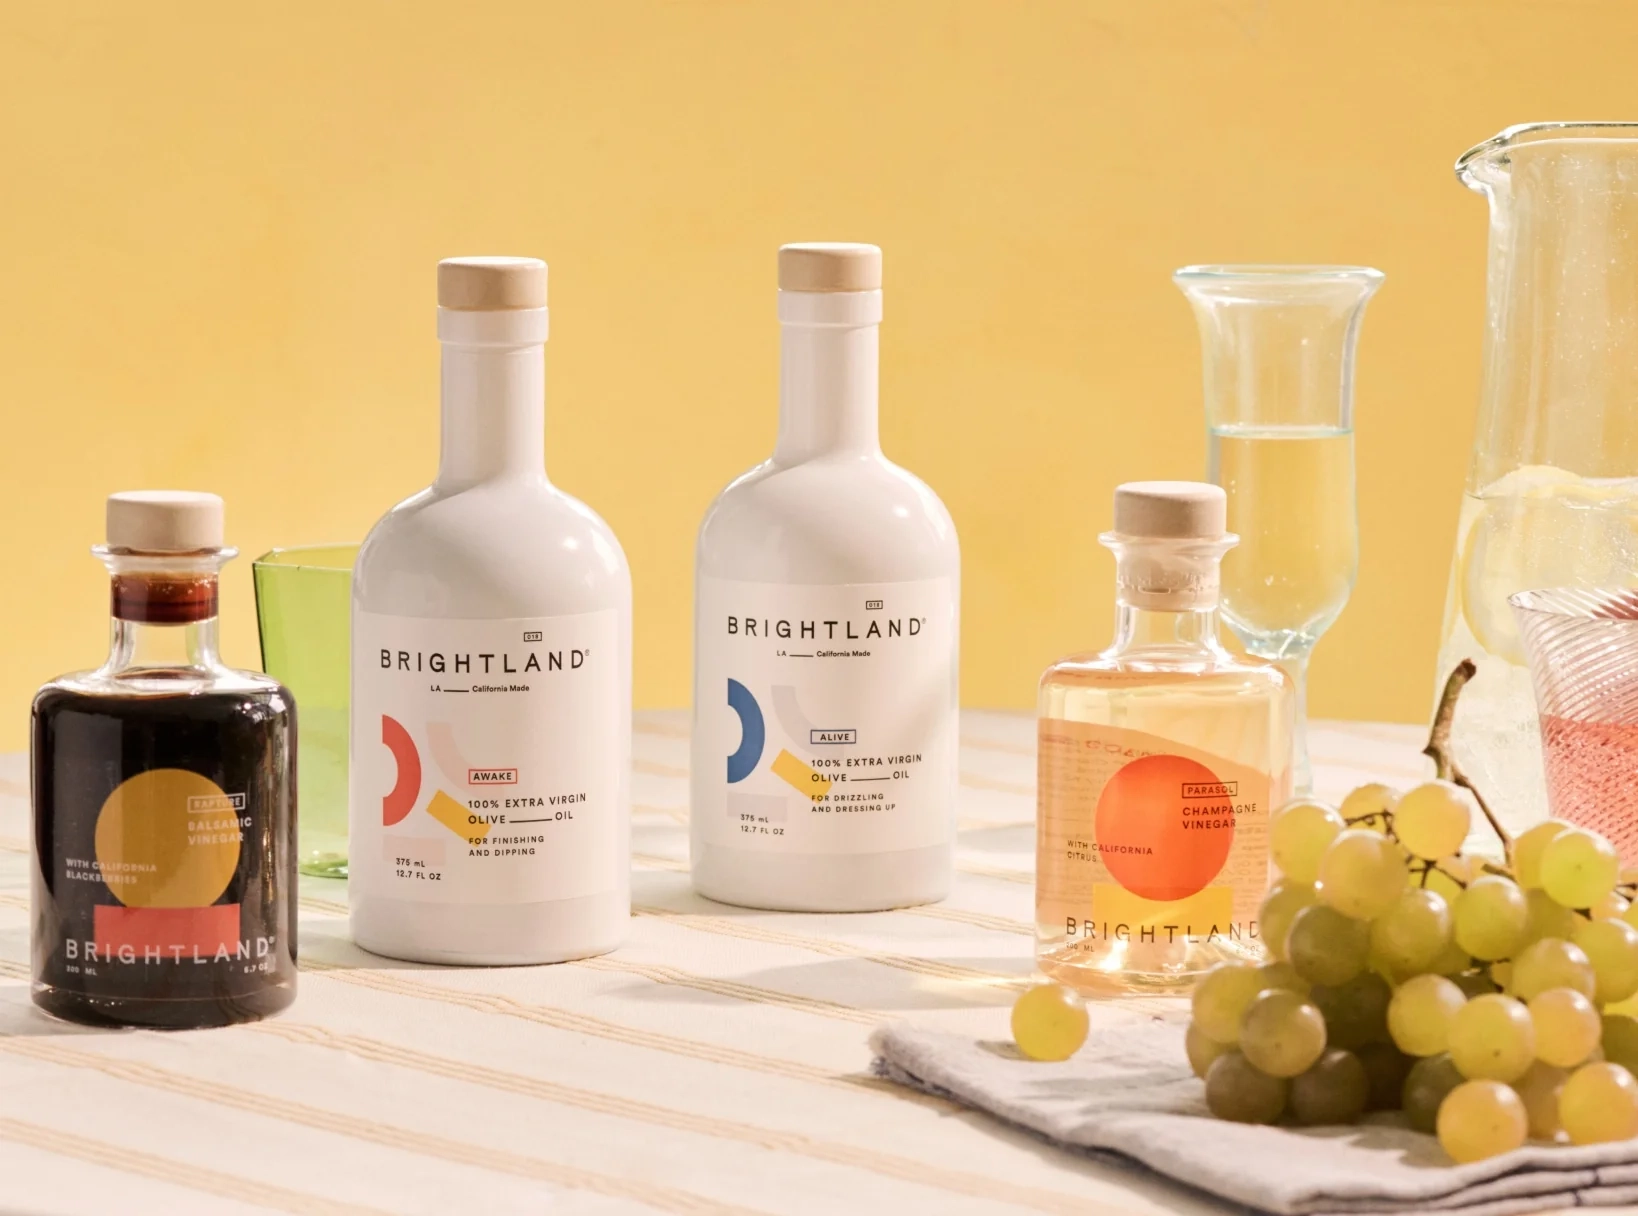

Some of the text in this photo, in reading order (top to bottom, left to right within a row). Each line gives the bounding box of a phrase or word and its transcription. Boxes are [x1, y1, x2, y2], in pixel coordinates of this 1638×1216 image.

[820, 733, 849, 741] ALIVE
[812, 754, 922, 767] 100% EXTRA VIRGIN
[473, 772, 512, 780] AWAKE
[811, 771, 909, 782] OLIVE OIL
[1187, 785, 1234, 795] PARASOL
[468, 793, 586, 809] 100% EXTRA VIRGIN
[1182, 804, 1257, 816] CHAMPAGNE
[468, 811, 573, 824] OLIVE OIL
[740, 814, 755, 822] 375
[188, 817, 252, 831] BALSAMIC
[1182, 819, 1236, 829] VINEGAR
[188, 832, 244, 846] VINEGAR
[493, 836, 544, 844] FINISHING
[495, 848, 536, 856] DIPPING
[1067, 840, 1153, 855] WITH CALIFORNIA
[396, 858, 411, 866] 375
[1067, 852, 1097, 862] CITRUS
[66, 858, 157, 872] WITH CALIFORNIA
[396, 870, 413, 878] 12.7
